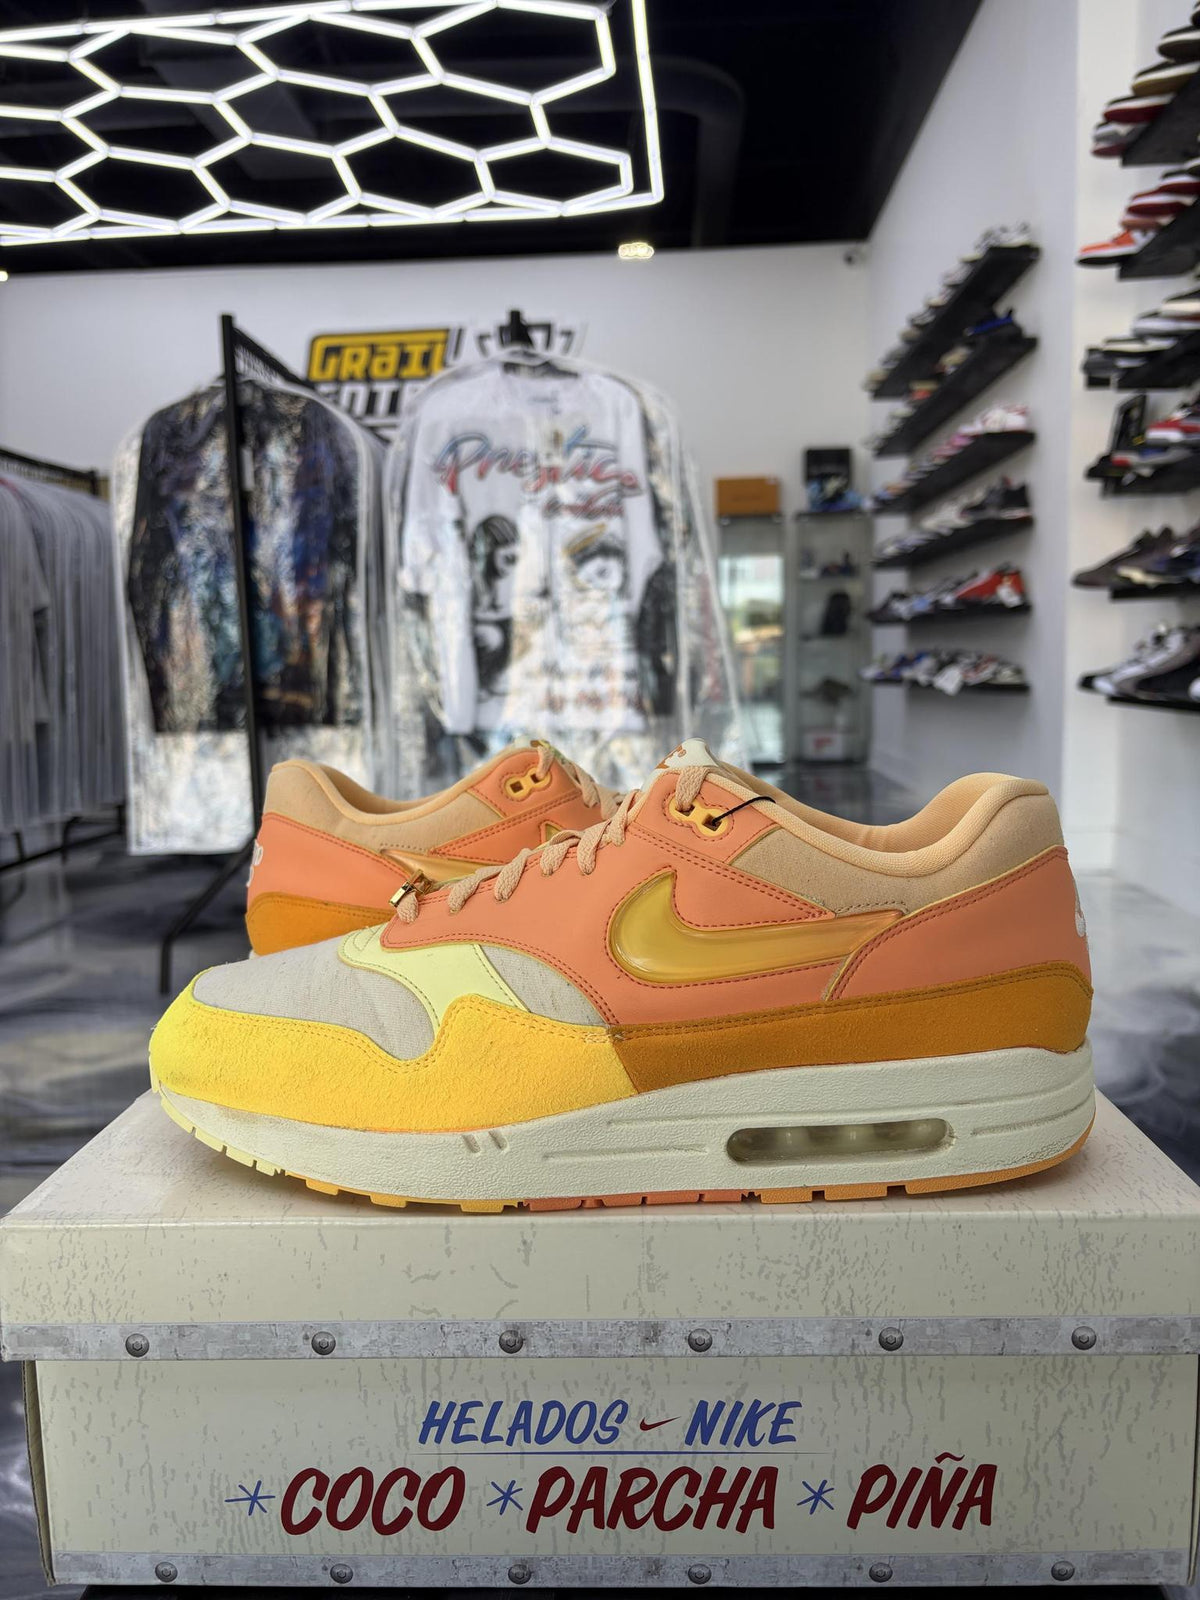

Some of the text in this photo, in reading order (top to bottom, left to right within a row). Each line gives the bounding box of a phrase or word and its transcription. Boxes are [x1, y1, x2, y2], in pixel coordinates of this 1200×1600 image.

[419, 1400, 802, 1446] HELADOS NIKE
[281, 1452, 998, 1535] COCO PARCHA PIÑA
